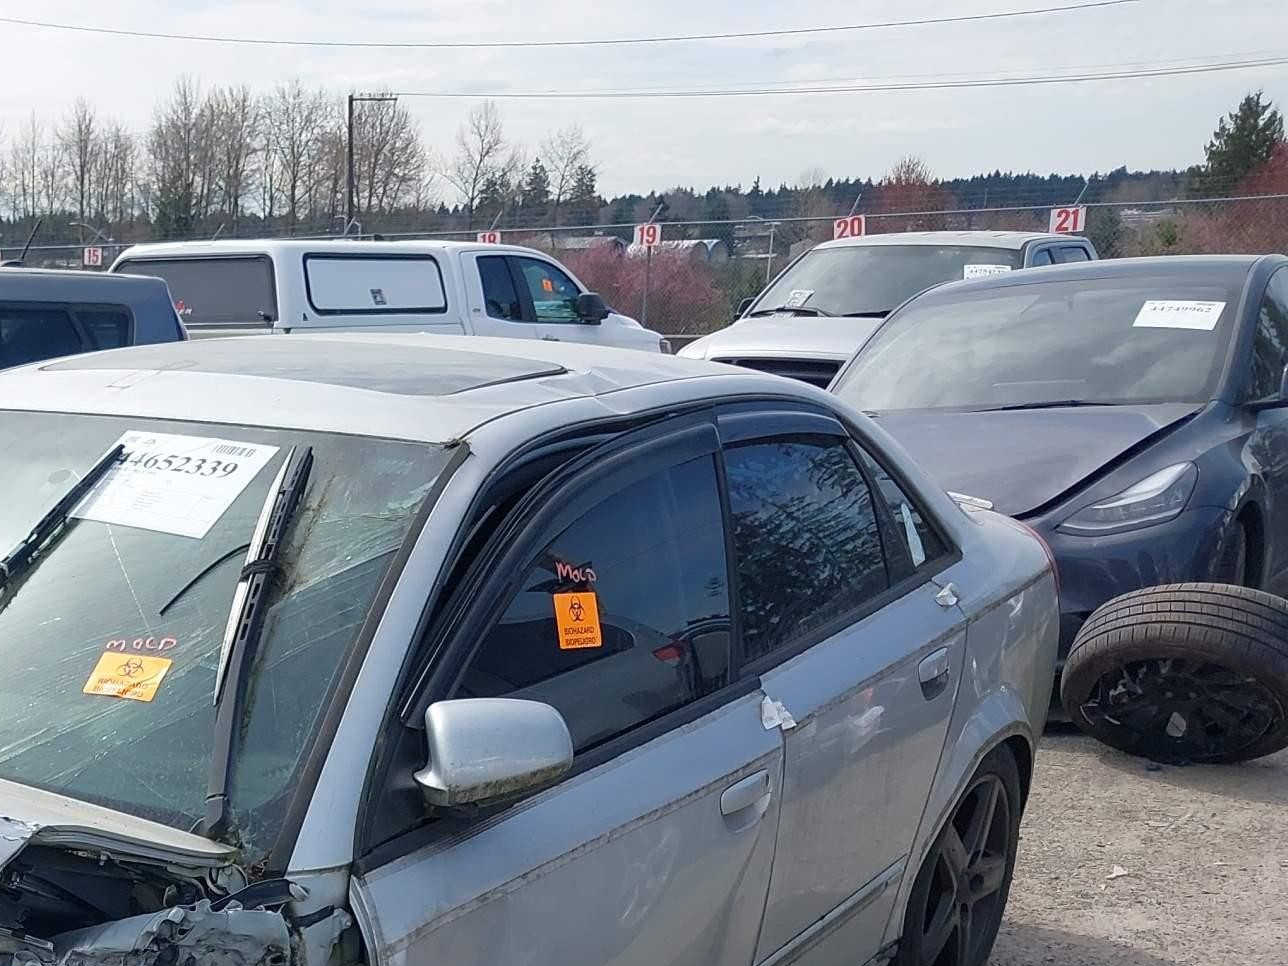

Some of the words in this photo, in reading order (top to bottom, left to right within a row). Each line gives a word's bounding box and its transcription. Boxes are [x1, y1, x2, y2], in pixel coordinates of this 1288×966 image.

[837, 216, 862, 239] 20
[1055, 208, 1079, 231] 21
[638, 225, 657, 245] 19
[87, 249, 100, 265] 15
[116, 450, 239, 478] 44652339
[564, 626, 595, 636] BIOHAZARD
